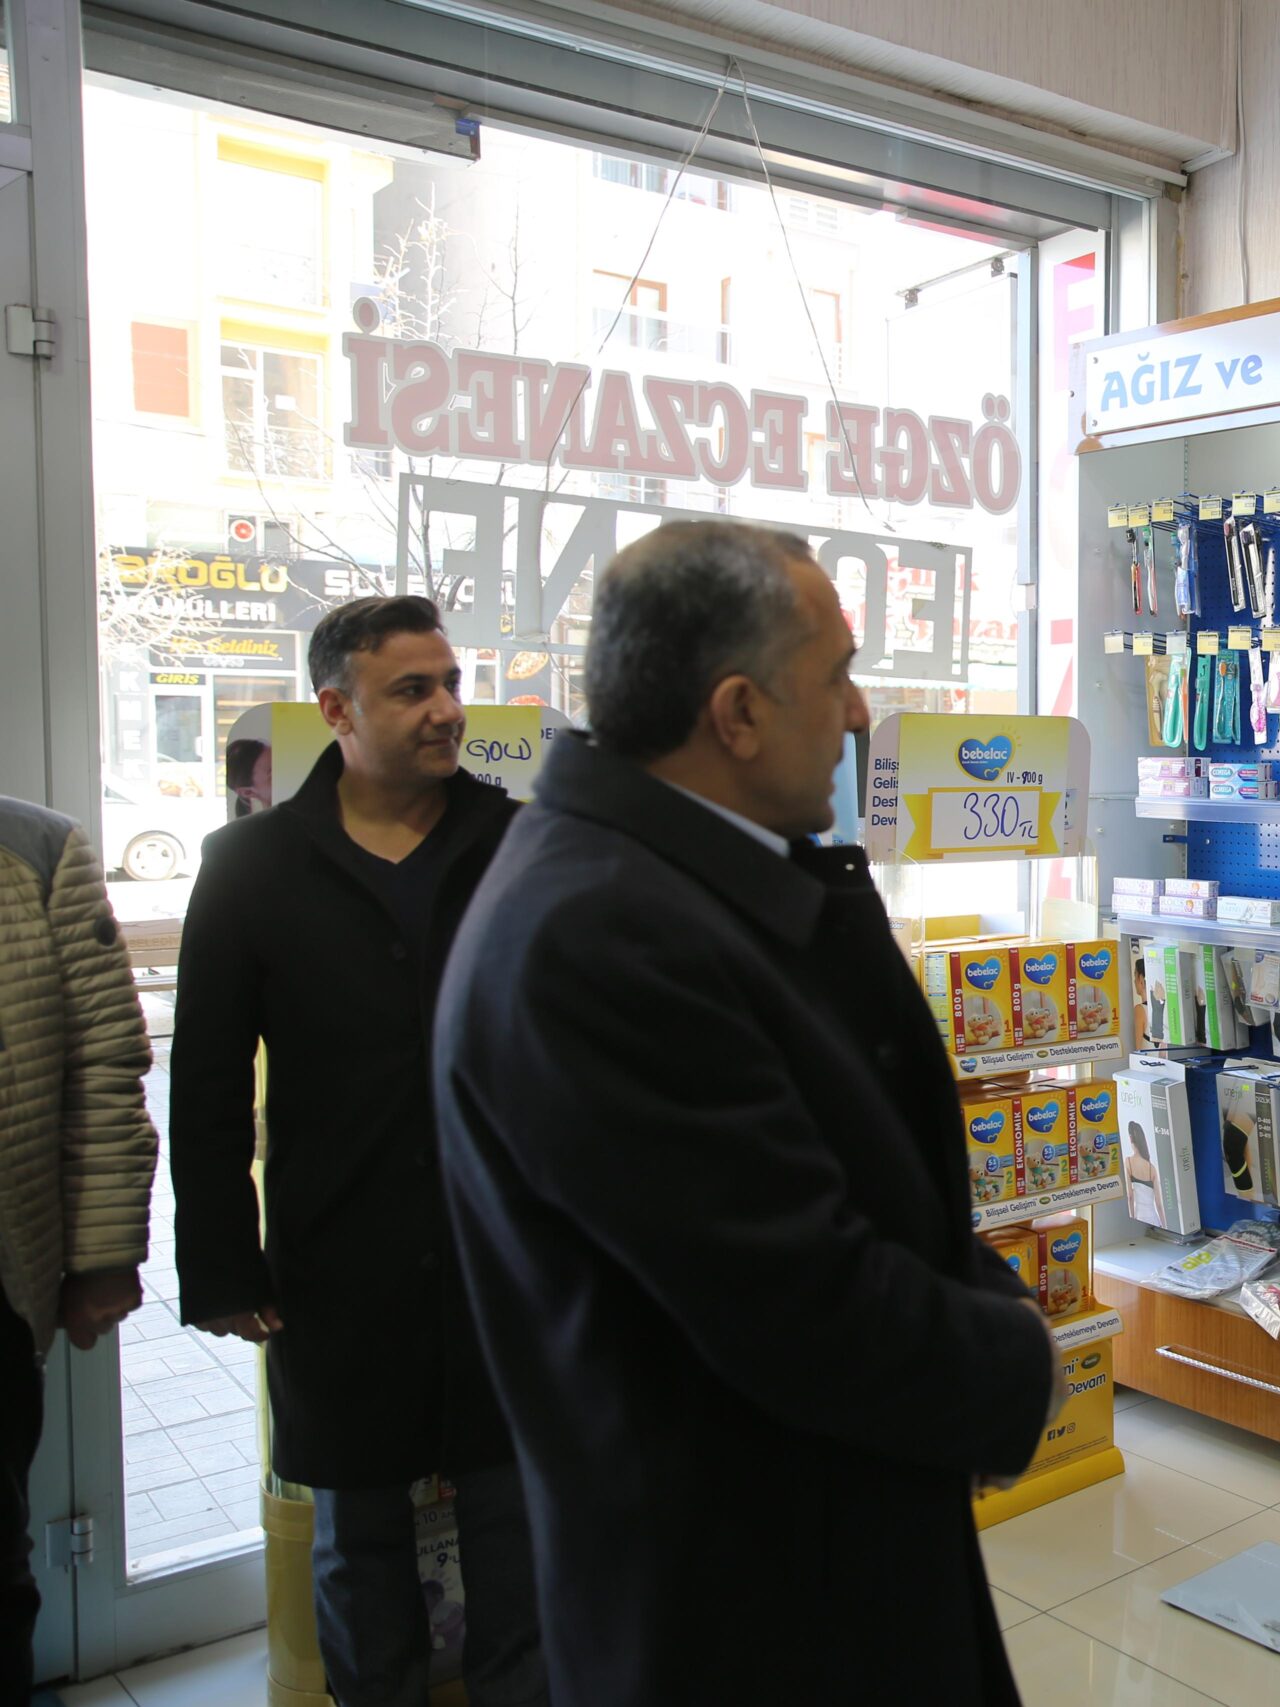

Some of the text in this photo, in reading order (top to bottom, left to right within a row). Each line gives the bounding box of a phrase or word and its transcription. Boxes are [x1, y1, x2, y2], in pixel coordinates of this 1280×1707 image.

[1100, 350, 1203, 412] AĞIZ
[1215, 354, 1263, 390] ve
[961, 747, 1008, 760] bebelac
[1006, 771, 1015, 783] IV
[1037, 774, 1043, 785] g
[963, 792, 1020, 840] 330
[1025, 961, 1055, 972] bebelac
[1081, 958, 1108, 967] bebelac
[967, 967, 998, 977] bebelac
[1060, 1013, 1067, 1026] 1
[1112, 1008, 1119, 1020] 1
[1004, 1019, 1012, 1033] 1
[1049, 1044, 1096, 1057] Desteklemeye
[1096, 1042, 1119, 1051] Devam
[1081, 1100, 1109, 1111] bebelac
[1028, 1110, 1057, 1122] bebelac
[971, 1120, 1002, 1132] bebelac
[1111, 1148, 1118, 1160] 2
[1061, 1159, 1068, 1172] 2
[1006, 1171, 1013, 1184] 2
[1052, 1187, 1097, 1201] Desteklemeye
[1097, 1180, 1120, 1190] Devam
[1052, 1240, 1080, 1253] bebelac
[1097, 1316, 1120, 1328] Devam
